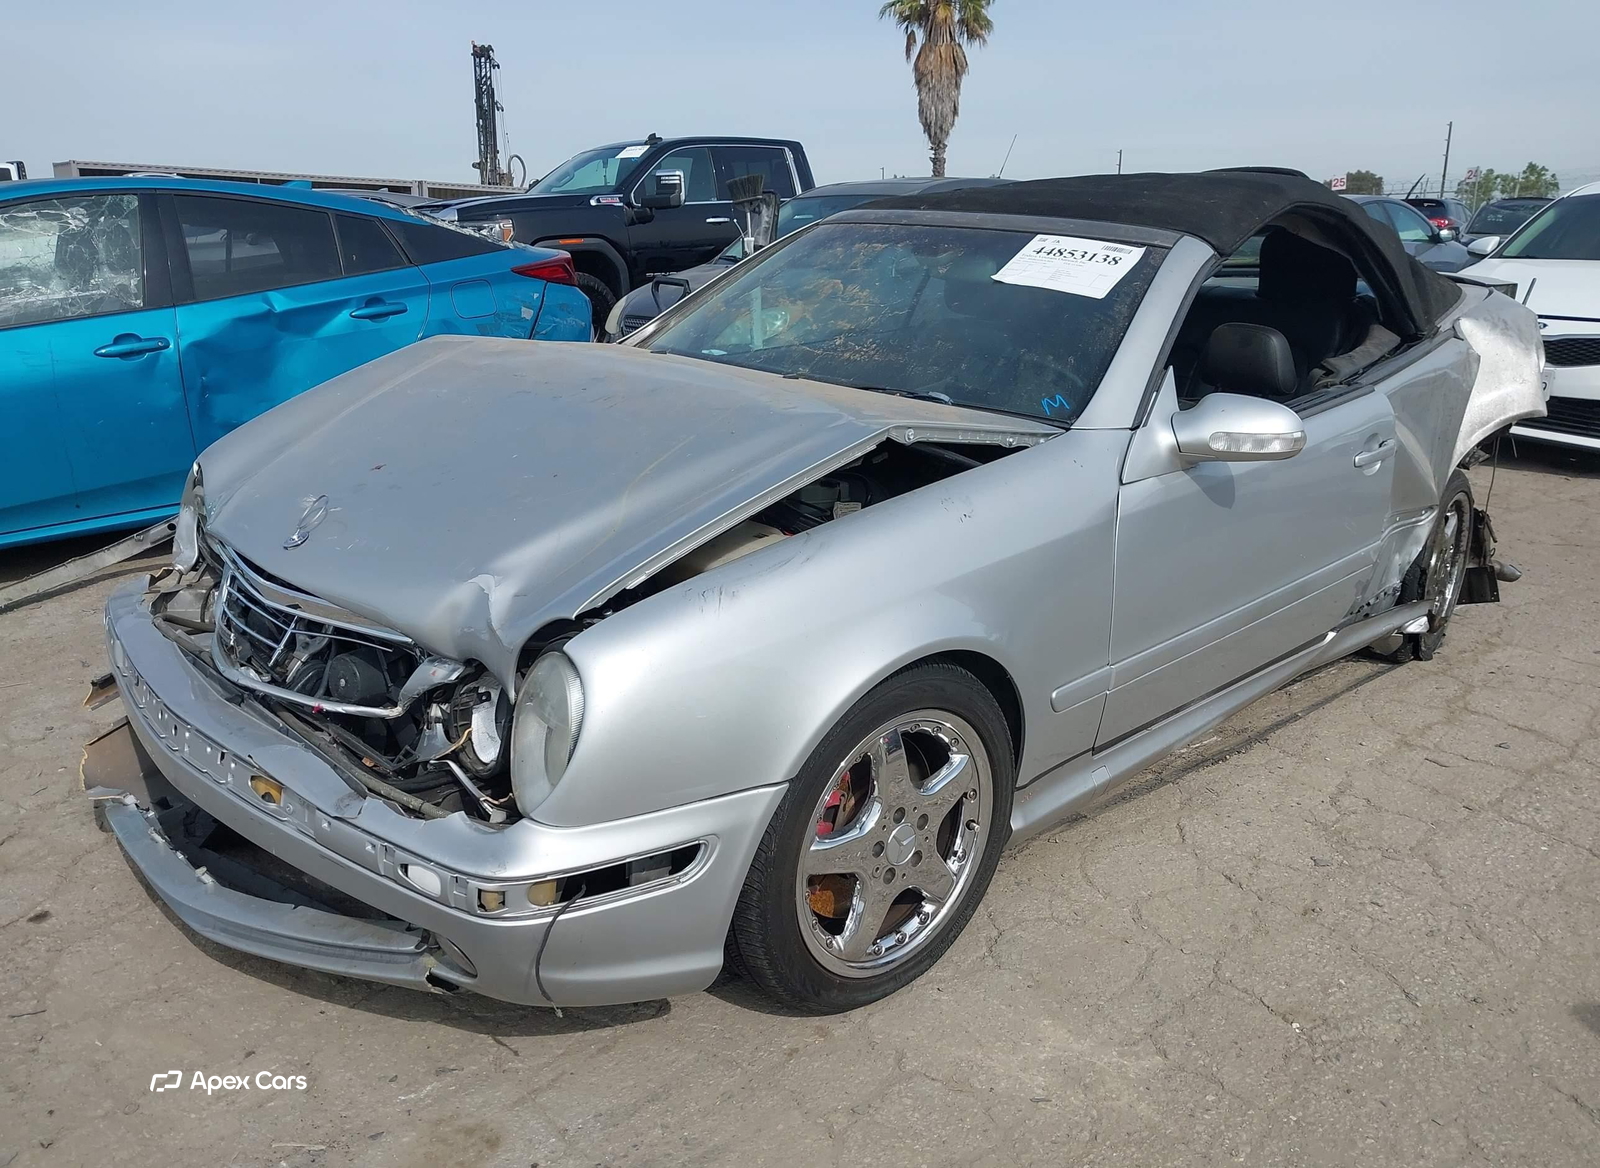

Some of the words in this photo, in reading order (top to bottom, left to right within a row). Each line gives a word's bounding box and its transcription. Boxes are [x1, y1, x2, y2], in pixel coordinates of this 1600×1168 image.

[1332, 177, 1346, 188] 25
[1032, 246, 1122, 266] 44853138
[1041, 394, 1070, 416] M
